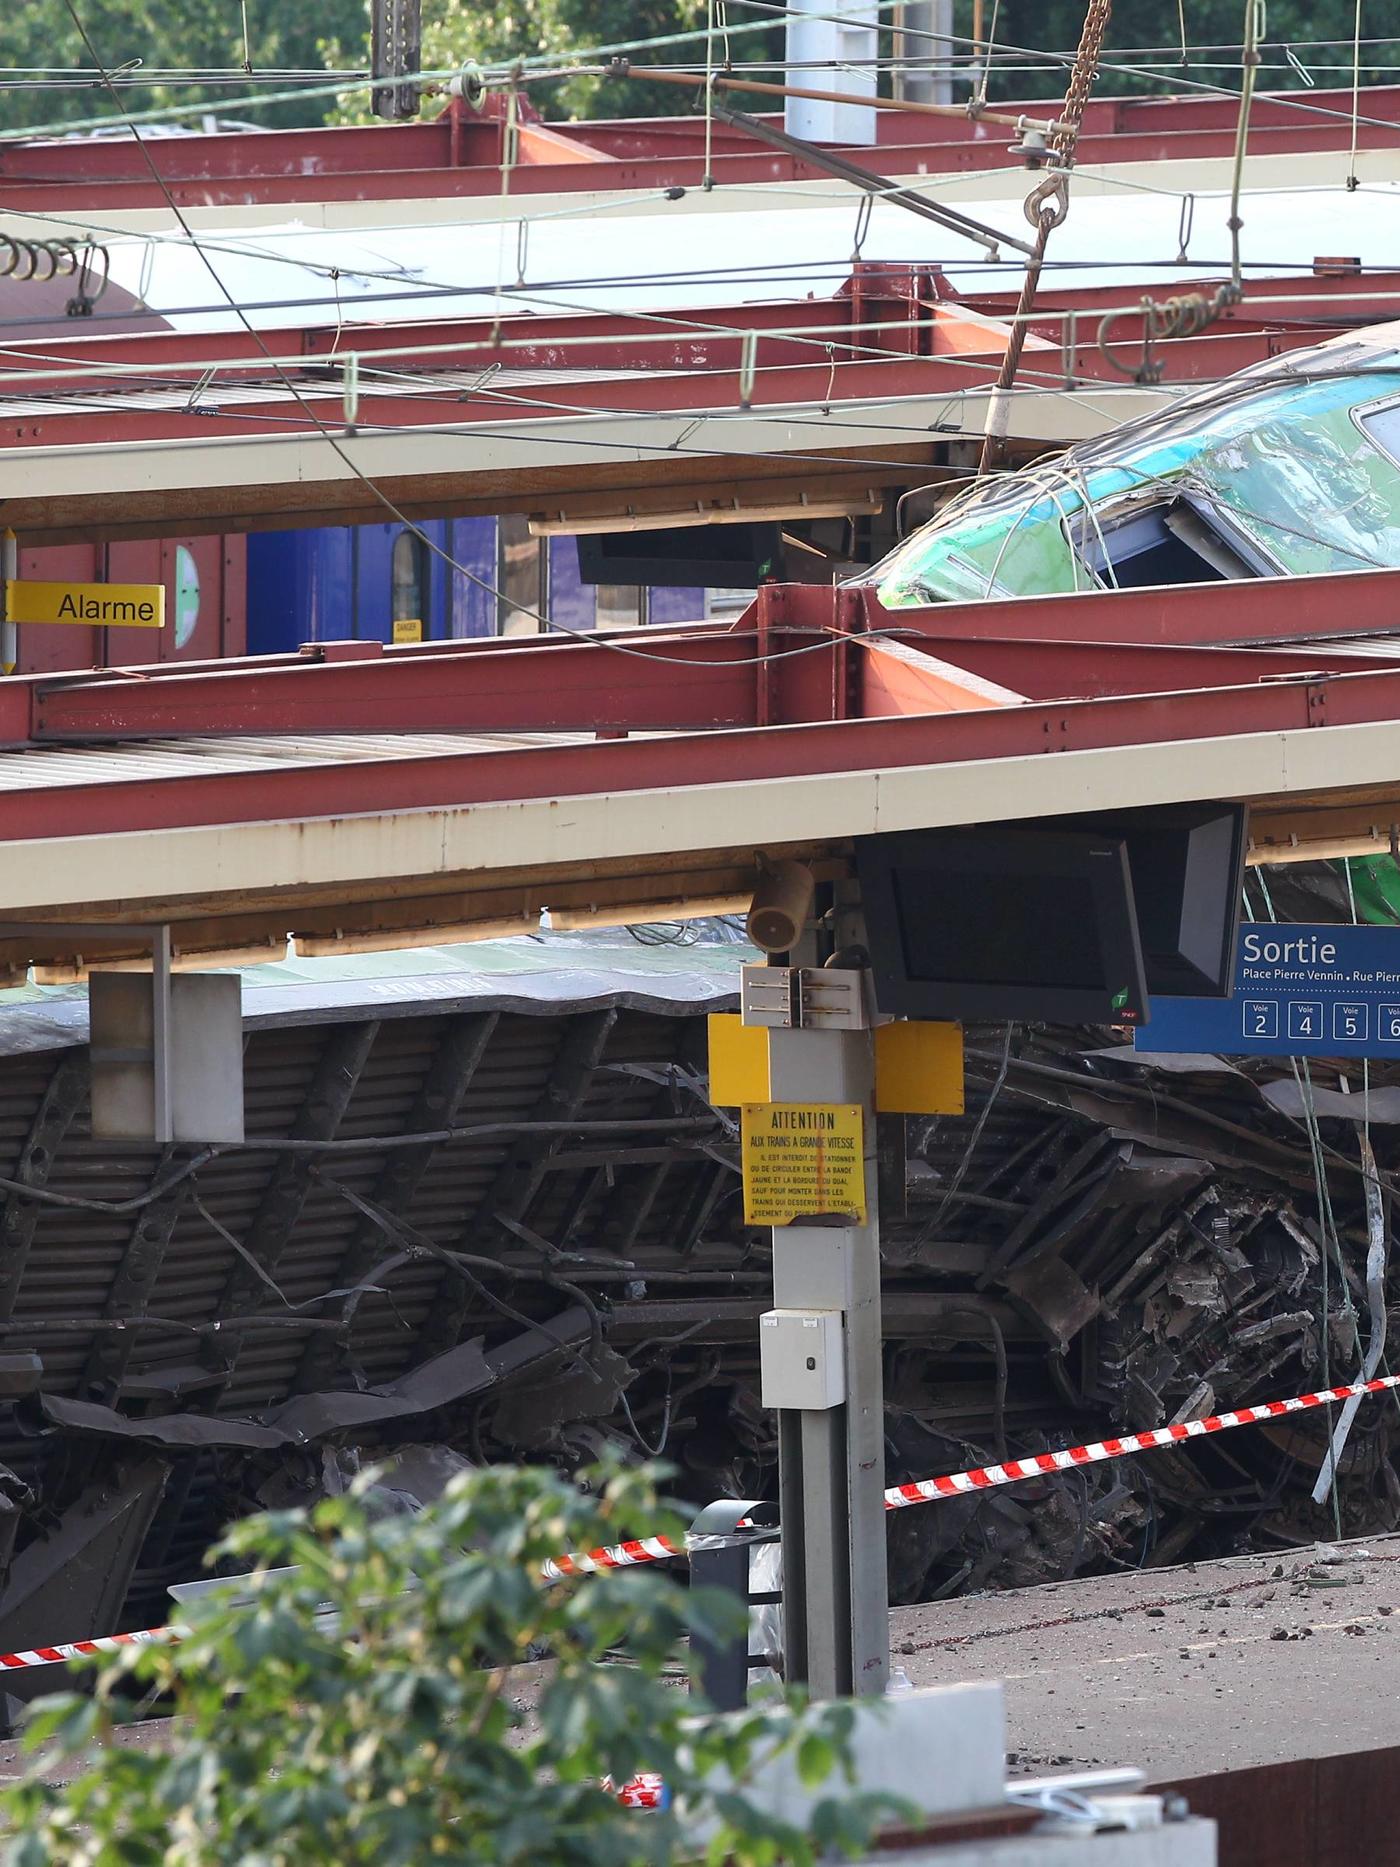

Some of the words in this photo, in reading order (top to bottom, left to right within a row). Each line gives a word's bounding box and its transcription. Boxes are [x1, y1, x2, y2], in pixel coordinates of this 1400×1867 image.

[57, 594, 154, 621] Alarme
[1243, 934, 1336, 964] Sortie
[1243, 968, 1271, 979] Place
[1274, 968, 1305, 980] Pierre
[1307, 970, 1343, 981] Vennin
[1353, 971, 1373, 981] Rue
[1255, 1016, 1266, 1033] 2
[1300, 1017, 1312, 1034] 4
[1345, 1018, 1356, 1035] 5
[1390, 1019, 1400, 1036] 6
[771, 1112, 834, 1129] ATTENTION
[750, 1136, 764, 1147] AUX
[767, 1136, 791, 1147] TRAINS
[793, 1136, 798, 1147] A
[800, 1136, 827, 1148] GRANDE
[828, 1137, 855, 1150] VITESSE
[787, 1199, 825, 1207] DESSERVENT
